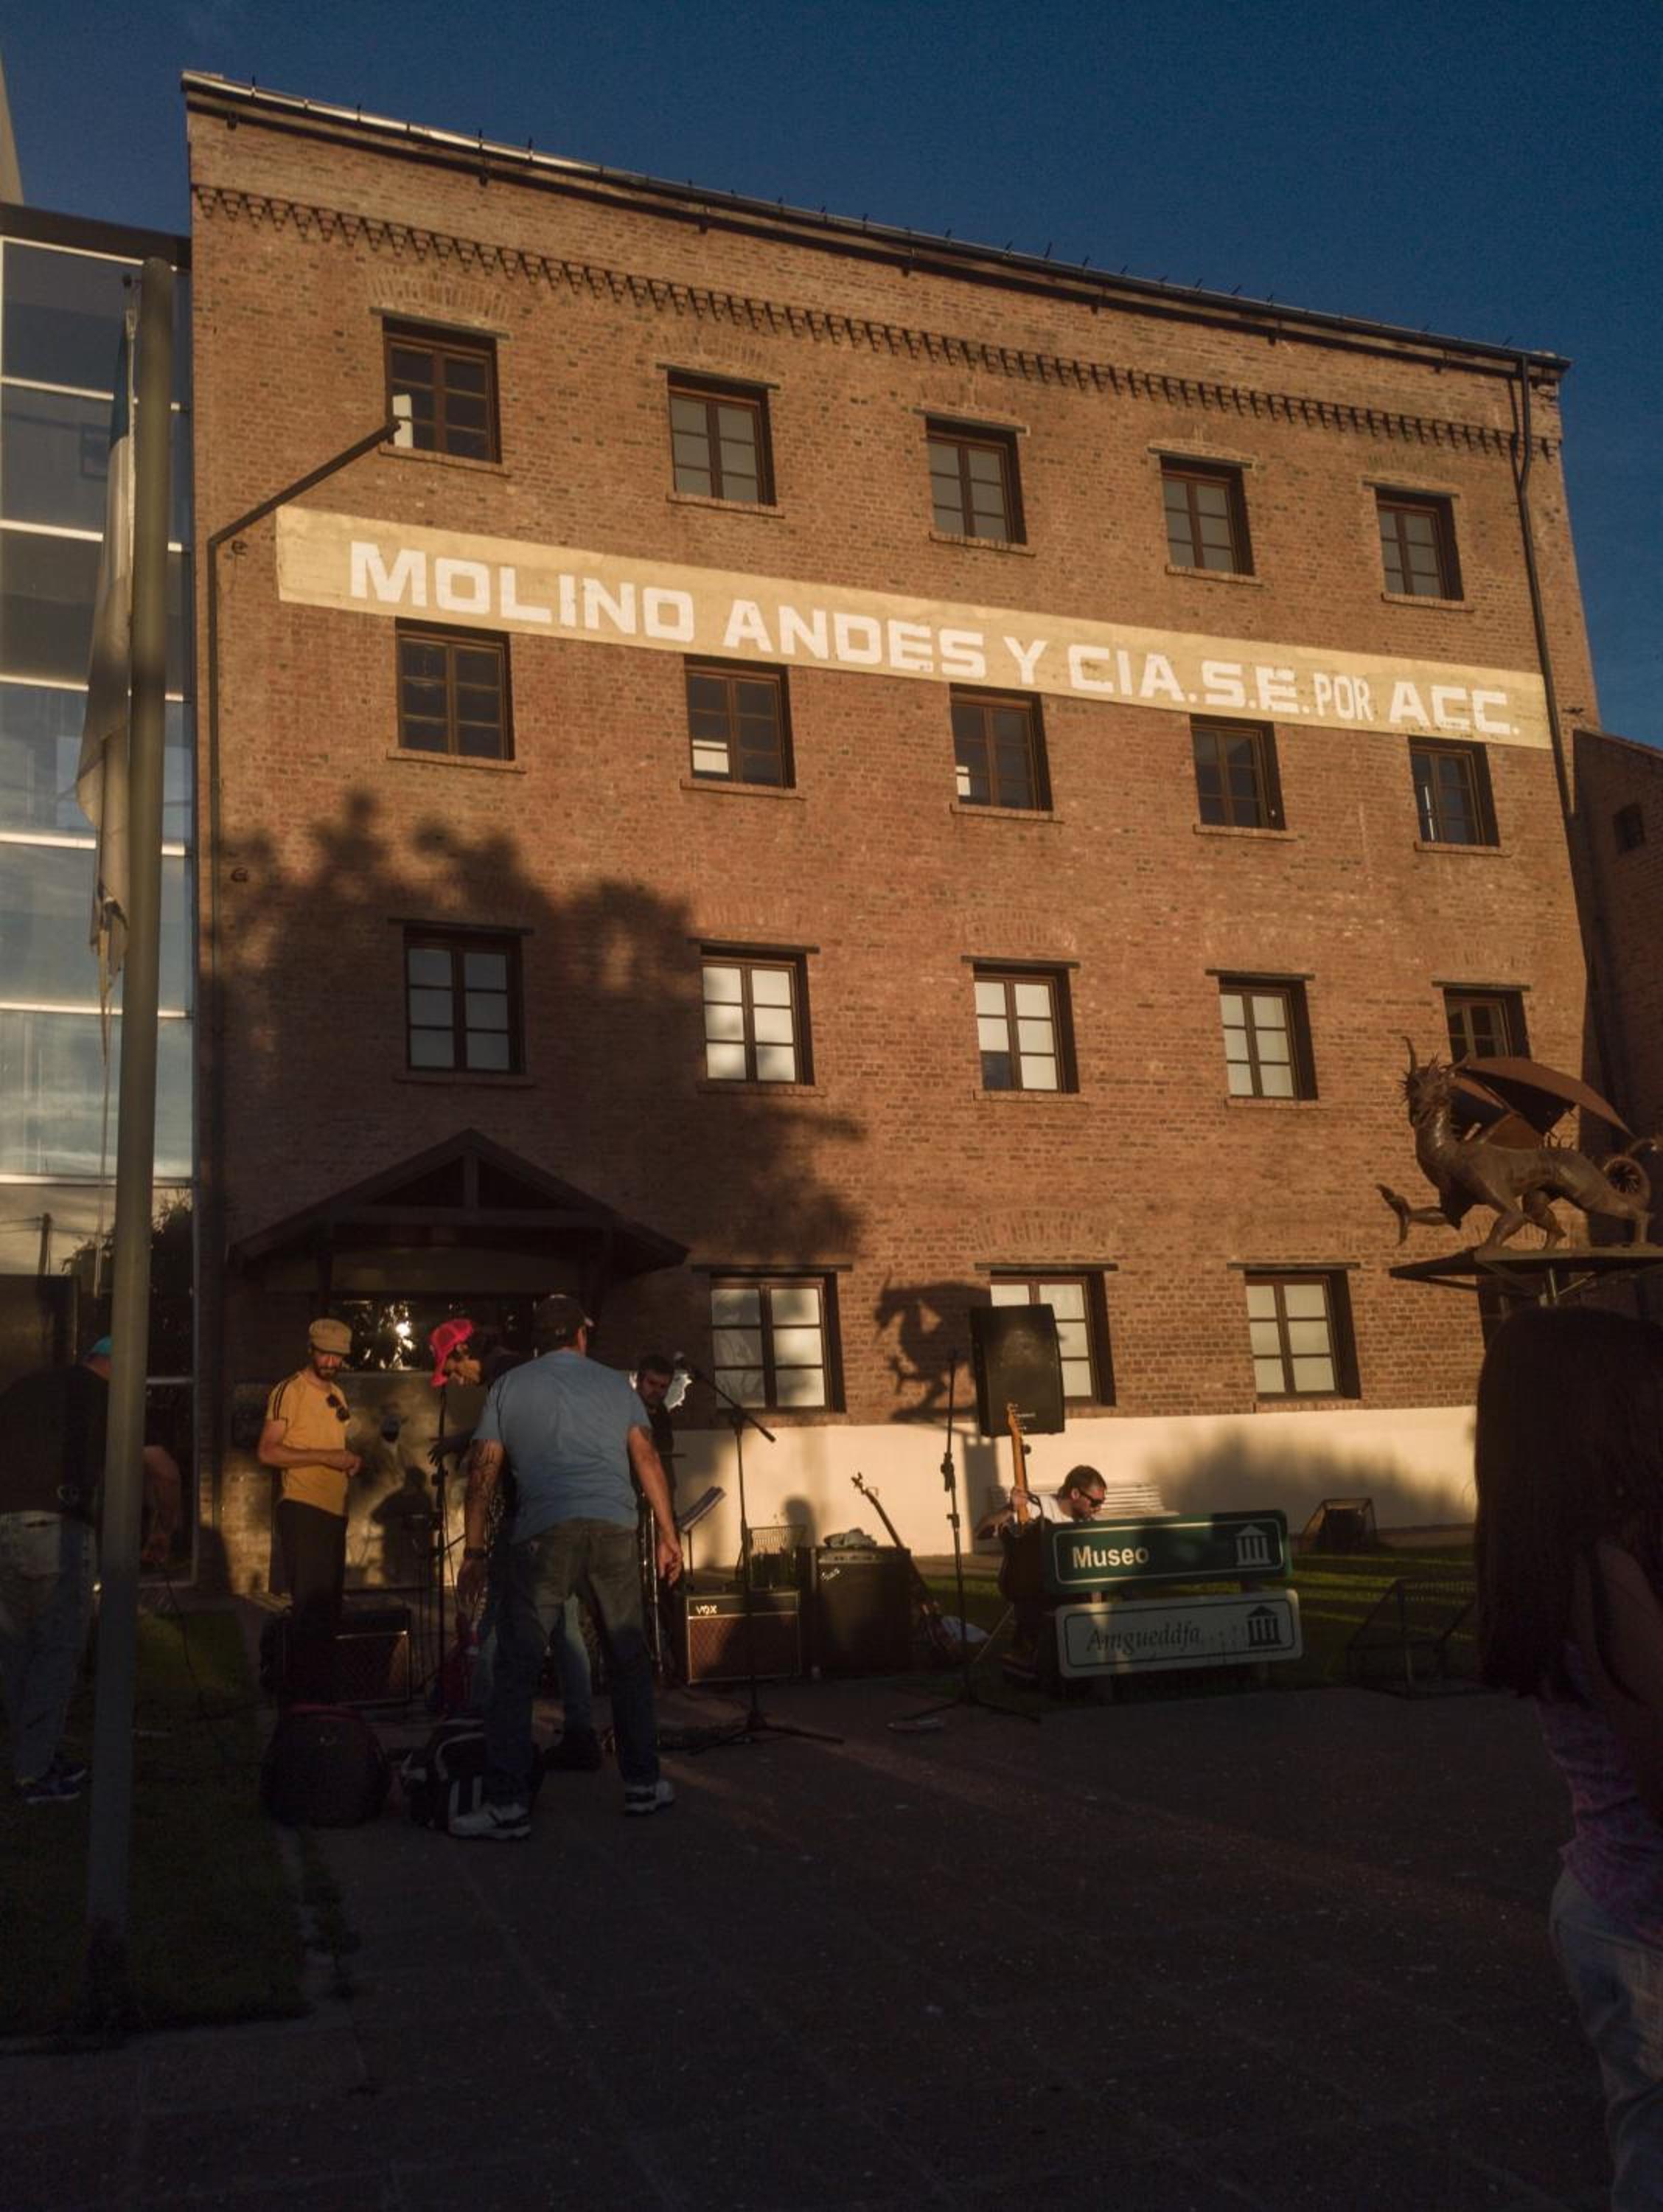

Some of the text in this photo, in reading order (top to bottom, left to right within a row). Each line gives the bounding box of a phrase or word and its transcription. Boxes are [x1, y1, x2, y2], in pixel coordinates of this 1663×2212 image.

[350, 540, 695, 643] MOLINO
[722, 599, 987, 679] ANDES
[1003, 636, 1049, 686] Y
[1390, 681, 1520, 735] ACC.
[1073, 1545, 1150, 1569] Museo
[695, 1604, 718, 1615] VOX
